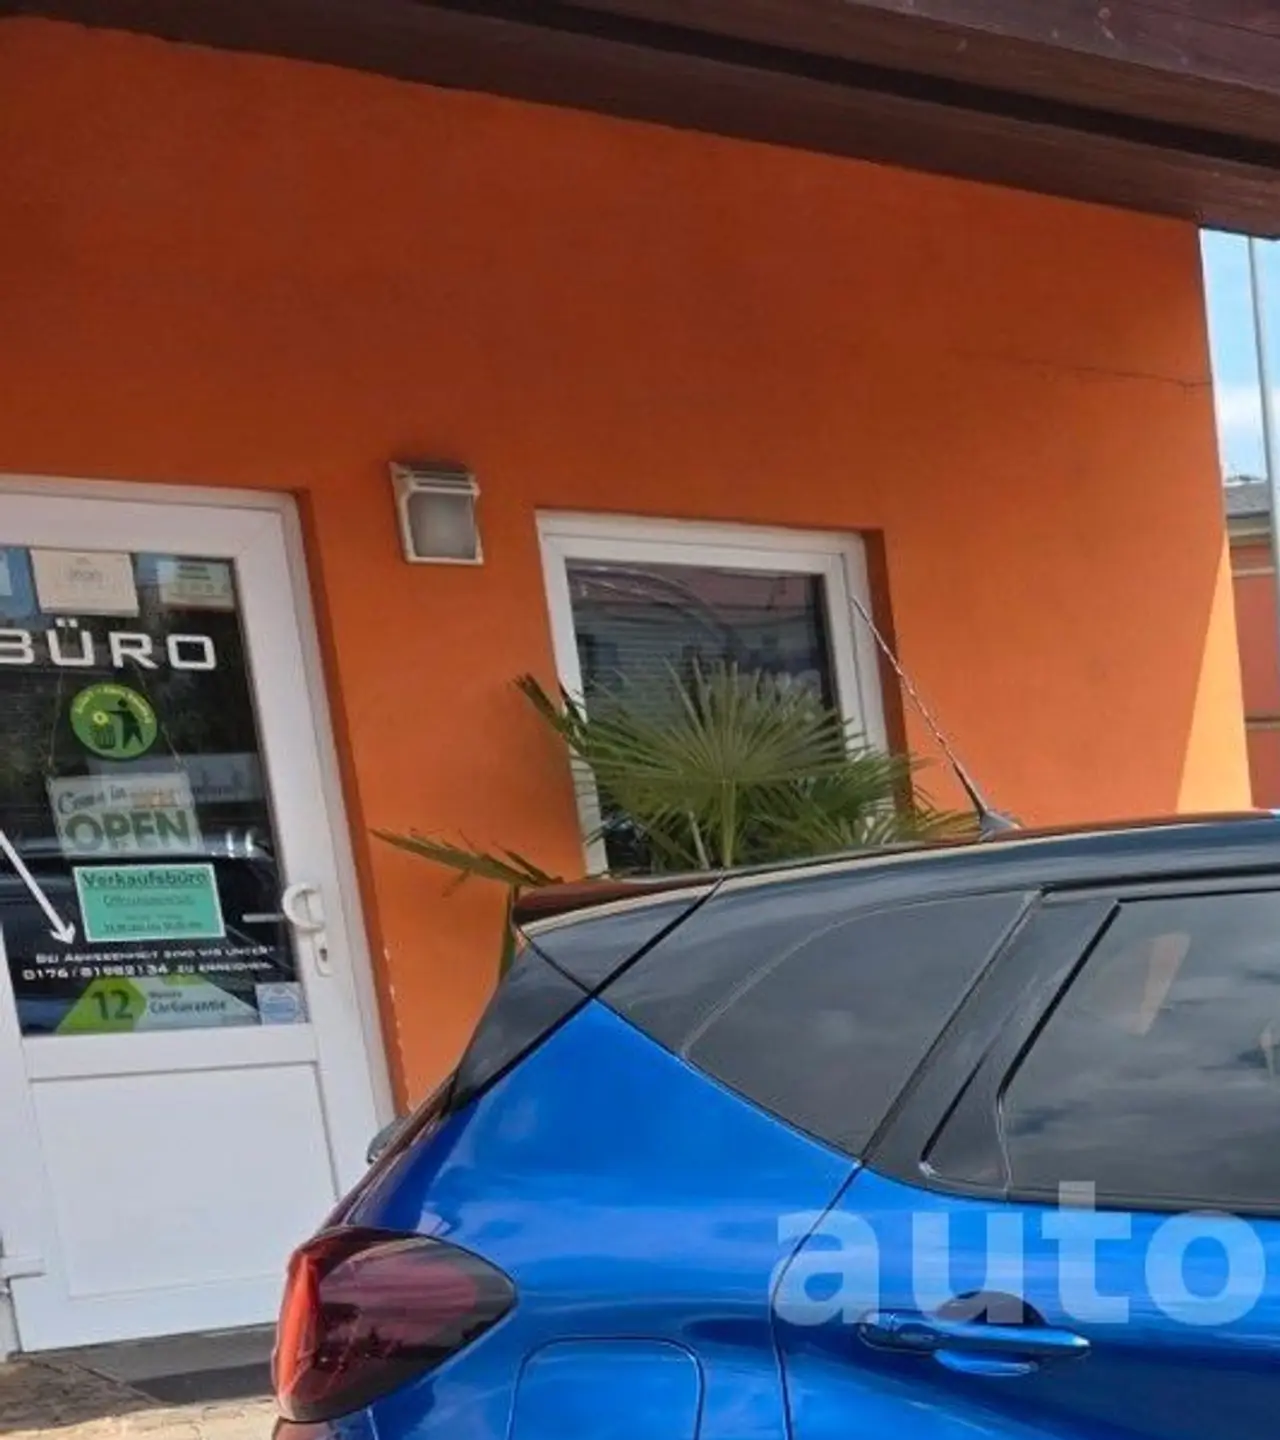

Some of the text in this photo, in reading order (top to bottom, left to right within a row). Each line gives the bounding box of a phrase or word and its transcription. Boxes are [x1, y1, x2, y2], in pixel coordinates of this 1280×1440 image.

[0, 618, 216, 671] BÜRO
[64, 809, 192, 851] OPEN
[91, 989, 134, 1021] 12
